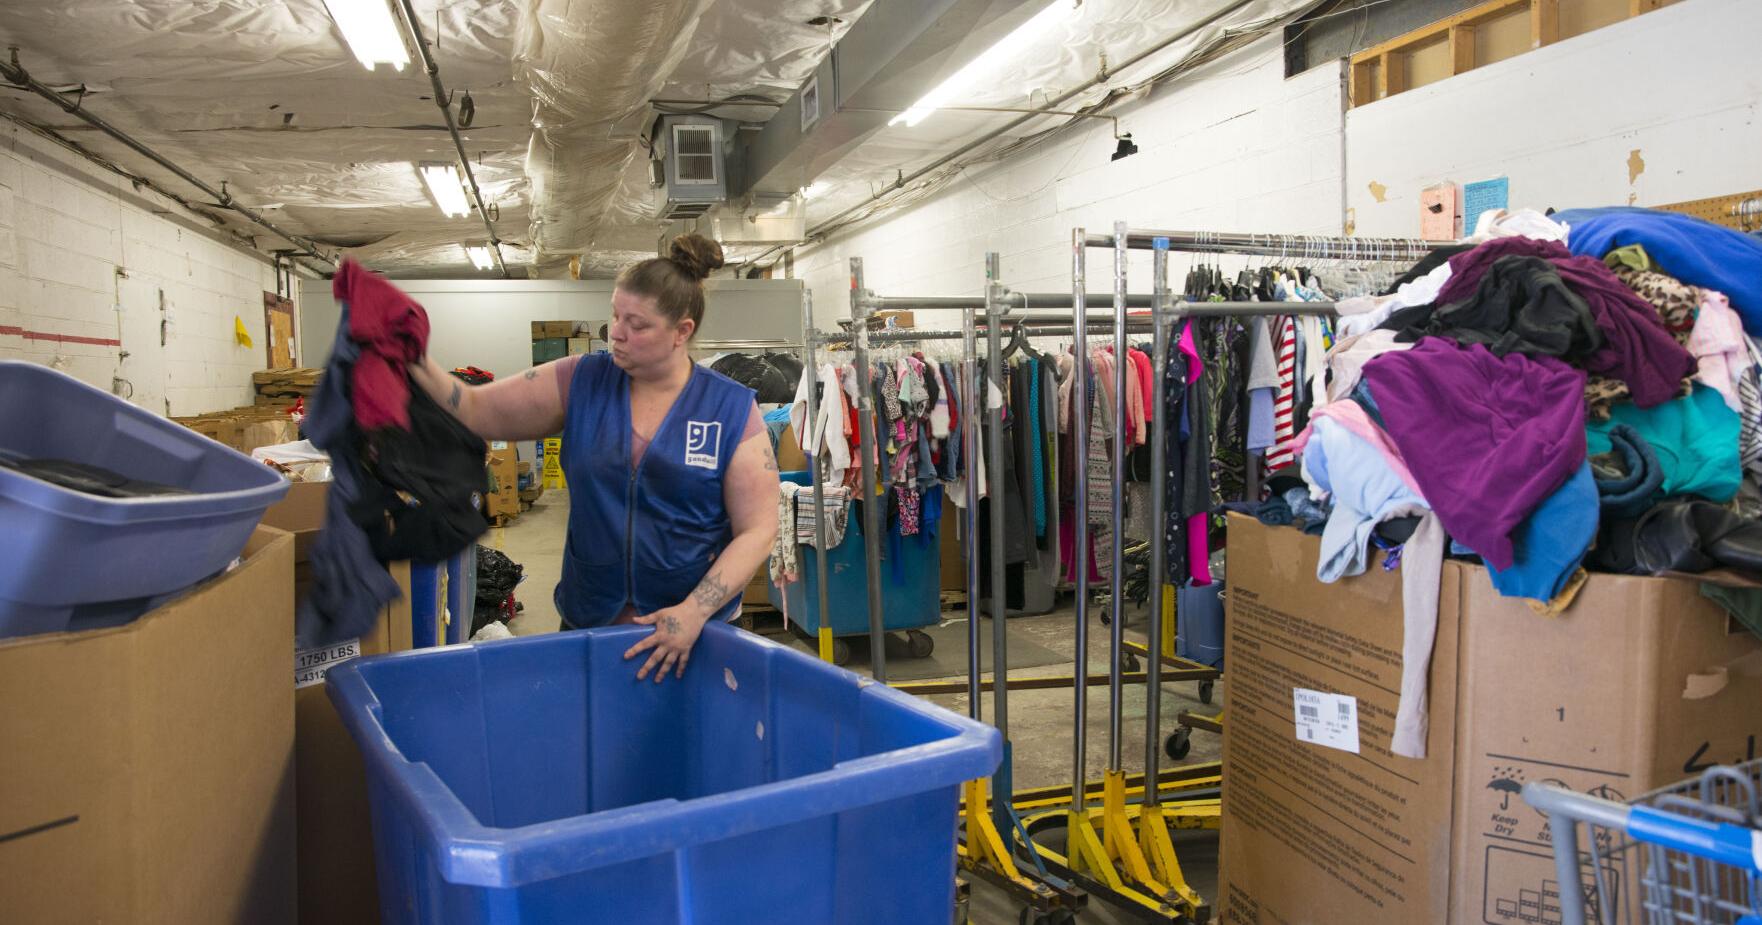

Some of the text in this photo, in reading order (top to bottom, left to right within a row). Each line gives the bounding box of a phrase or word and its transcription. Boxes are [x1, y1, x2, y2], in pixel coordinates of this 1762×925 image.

[300, 645, 358, 666] 1750 LBS.
[1491, 813, 1519, 825] Keep
[1494, 824, 1514, 836] Dry
